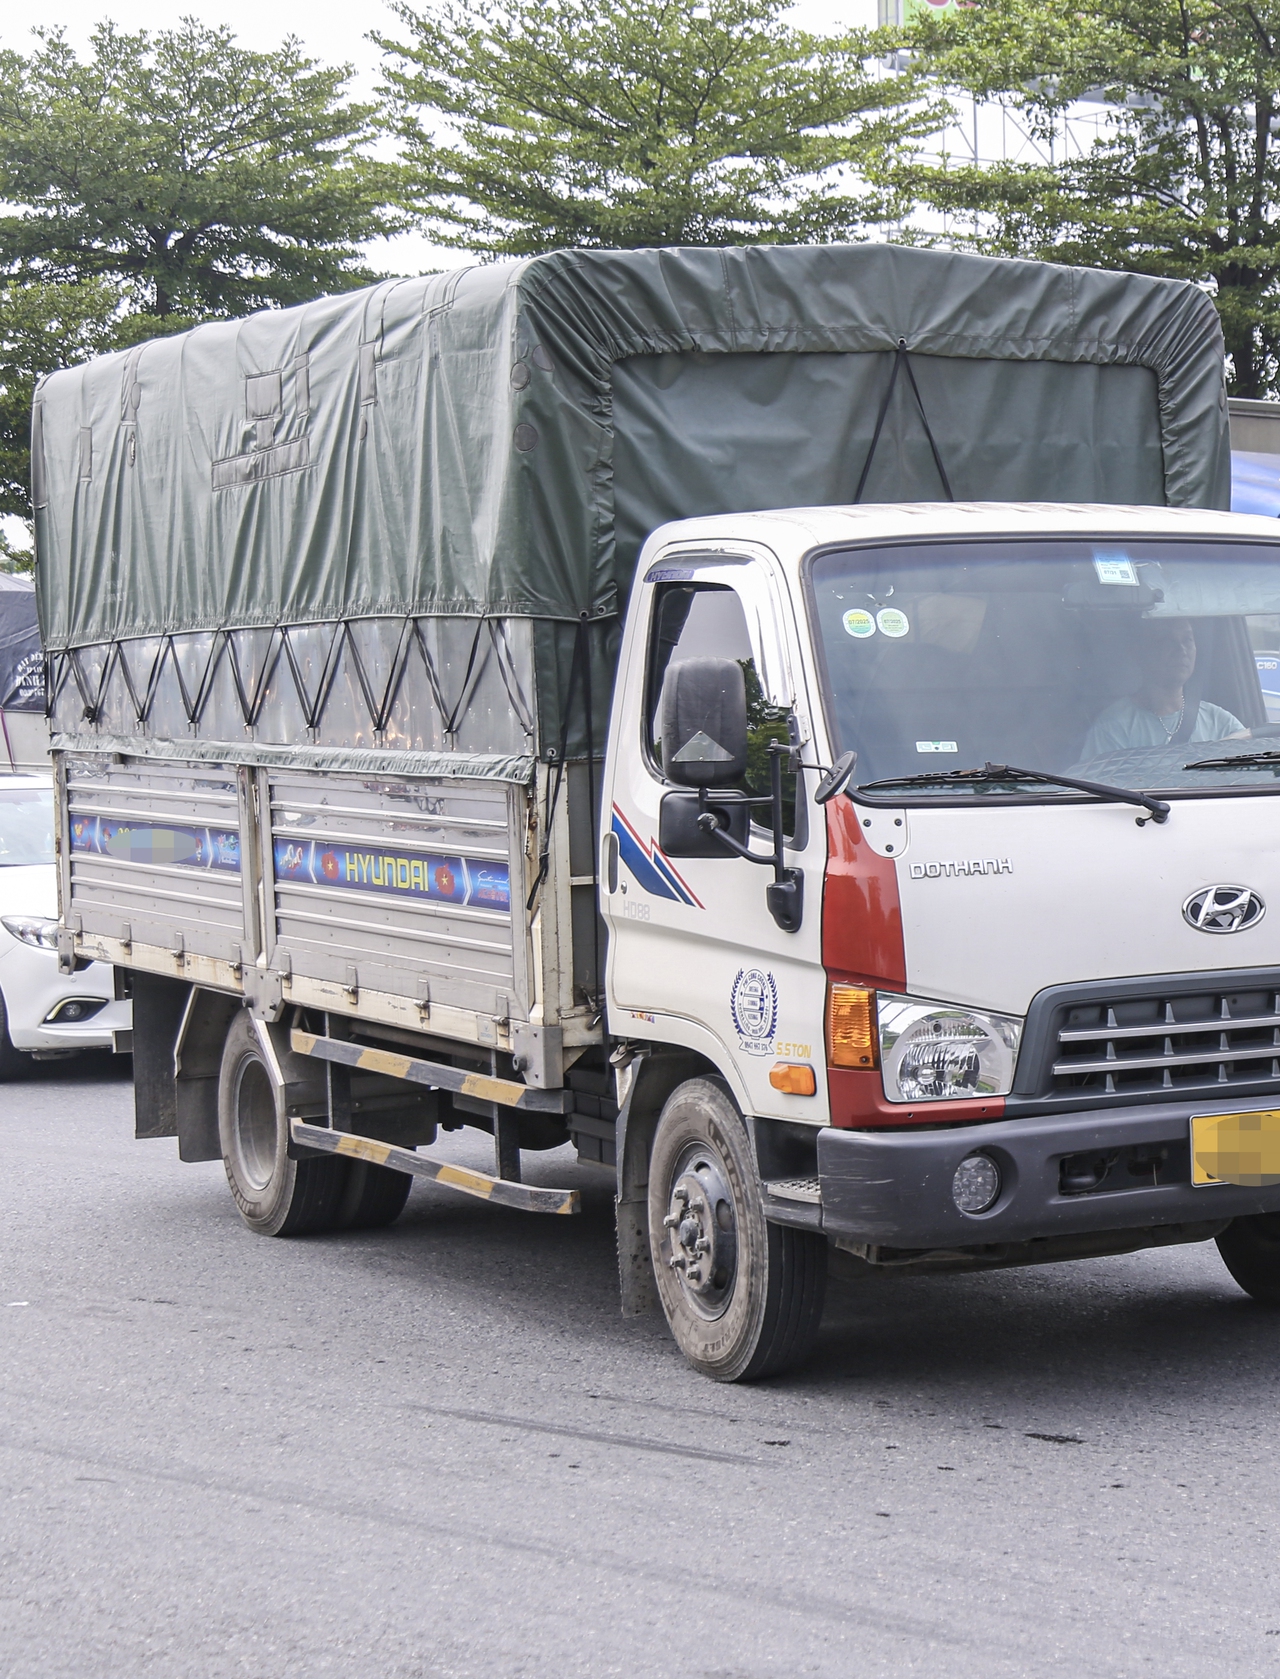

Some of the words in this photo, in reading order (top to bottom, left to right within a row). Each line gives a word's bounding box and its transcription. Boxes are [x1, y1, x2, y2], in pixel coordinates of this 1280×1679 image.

[345, 853, 430, 892] HYUNDAI
[909, 858, 1013, 879] DOTHANH
[623, 900, 651, 920] HD88
